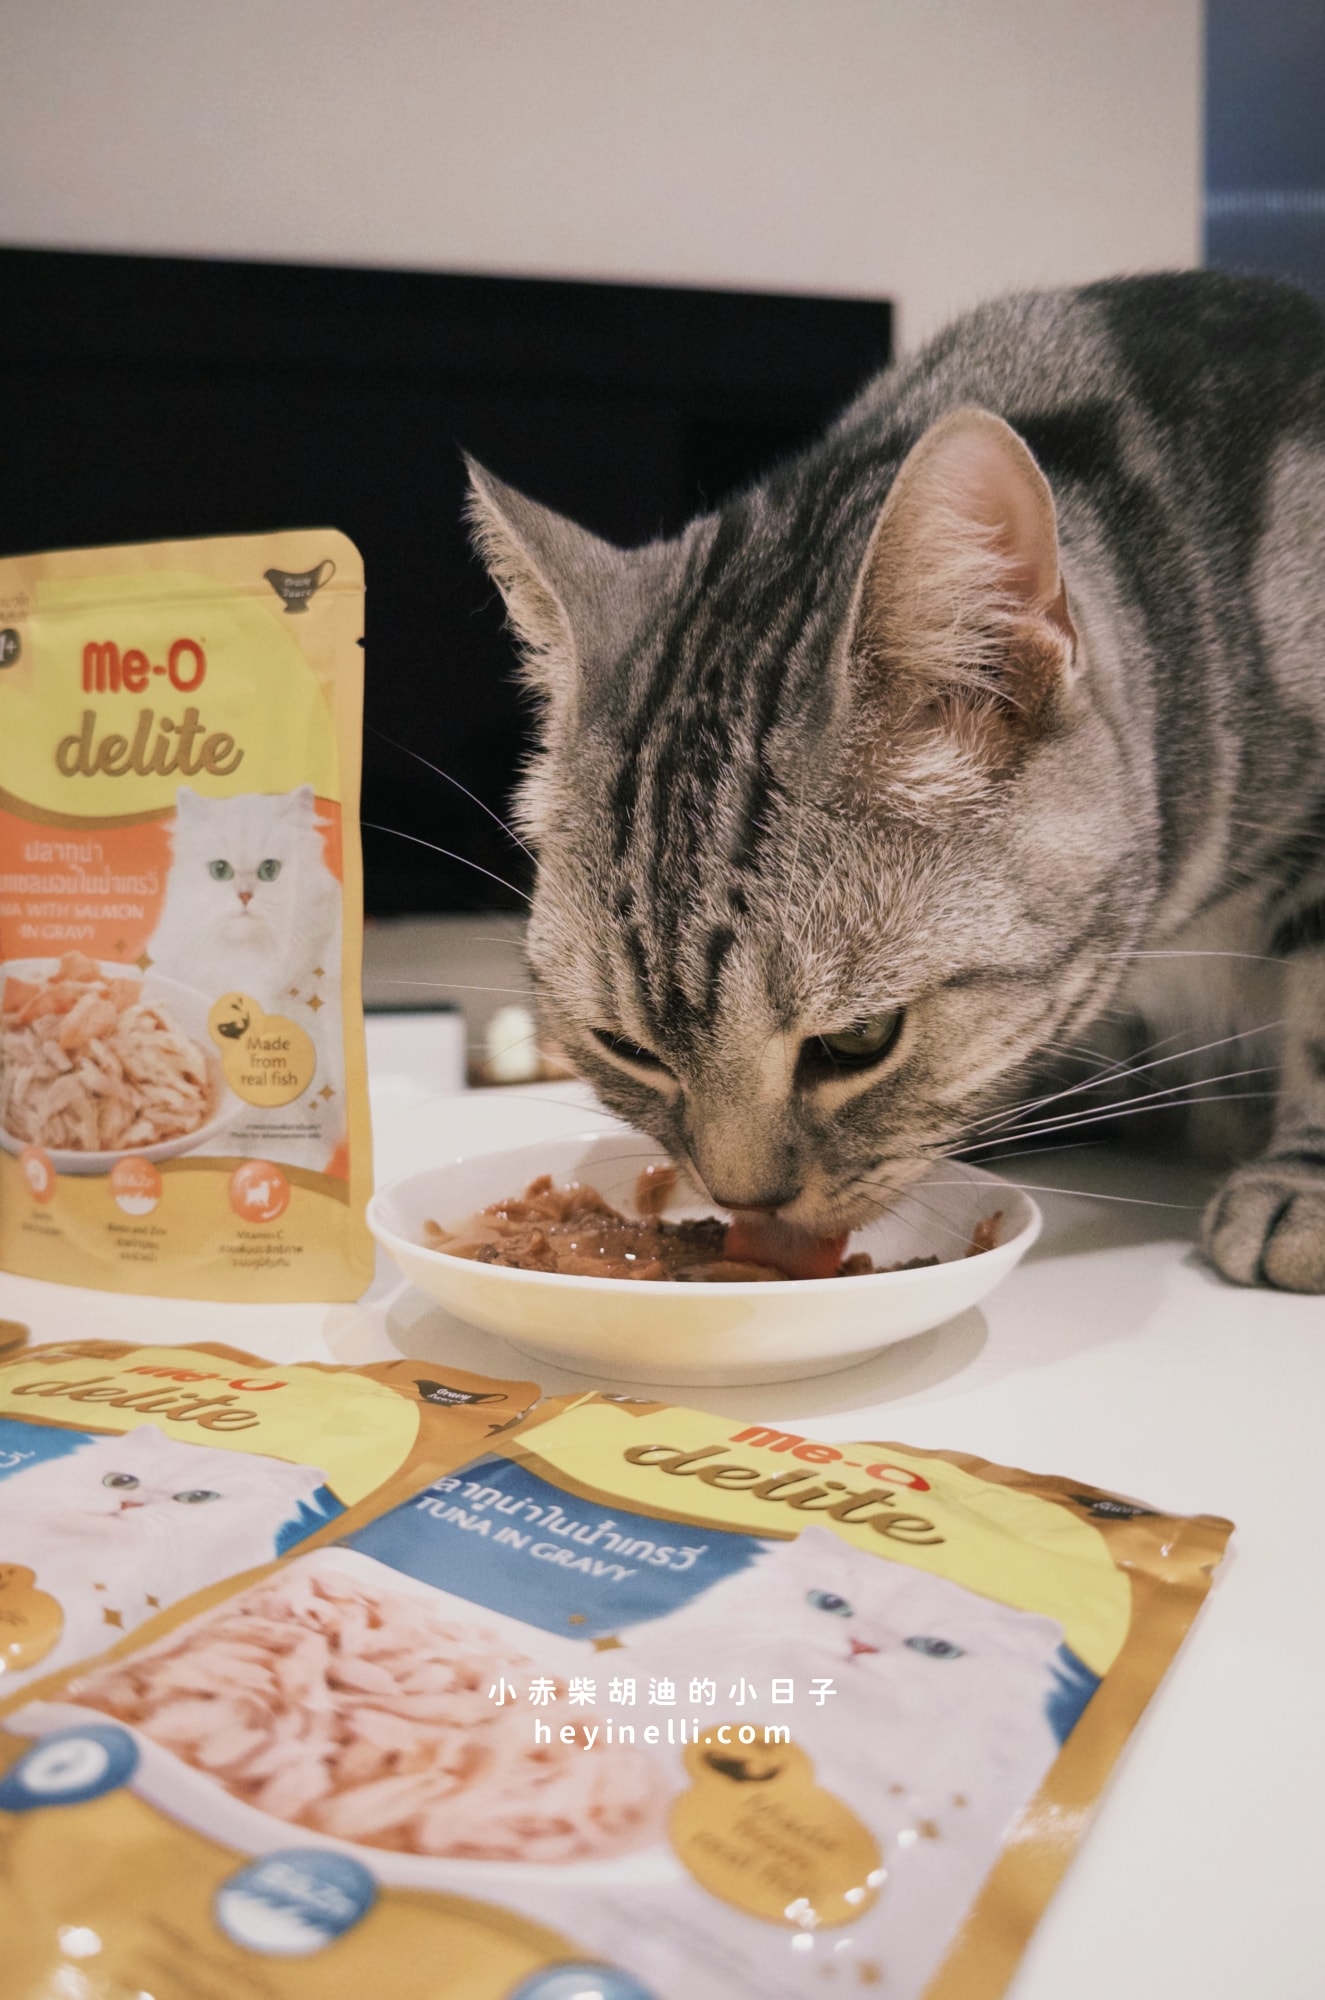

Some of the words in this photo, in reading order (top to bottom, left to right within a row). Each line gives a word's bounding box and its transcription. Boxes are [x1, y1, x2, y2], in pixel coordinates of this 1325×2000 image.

[55, 706, 244, 777] delite
[74, 903, 144, 920] SALMON
[42, 924, 96, 939] GRAVY
[246, 1037, 290, 1050] Made
[251, 1053, 287, 1068] from
[241, 1072, 267, 1085] real
[272, 1071, 298, 1086] fish
[11, 1376, 260, 1431] delite
[623, 1444, 945, 1545] delite
[416, 1496, 493, 1536] TUNA
[493, 1526, 533, 1549] IN
[529, 1541, 638, 1582] GRAVY
[430, 1476, 709, 1571] ลาทูน่าในน้ำเกรวี่
